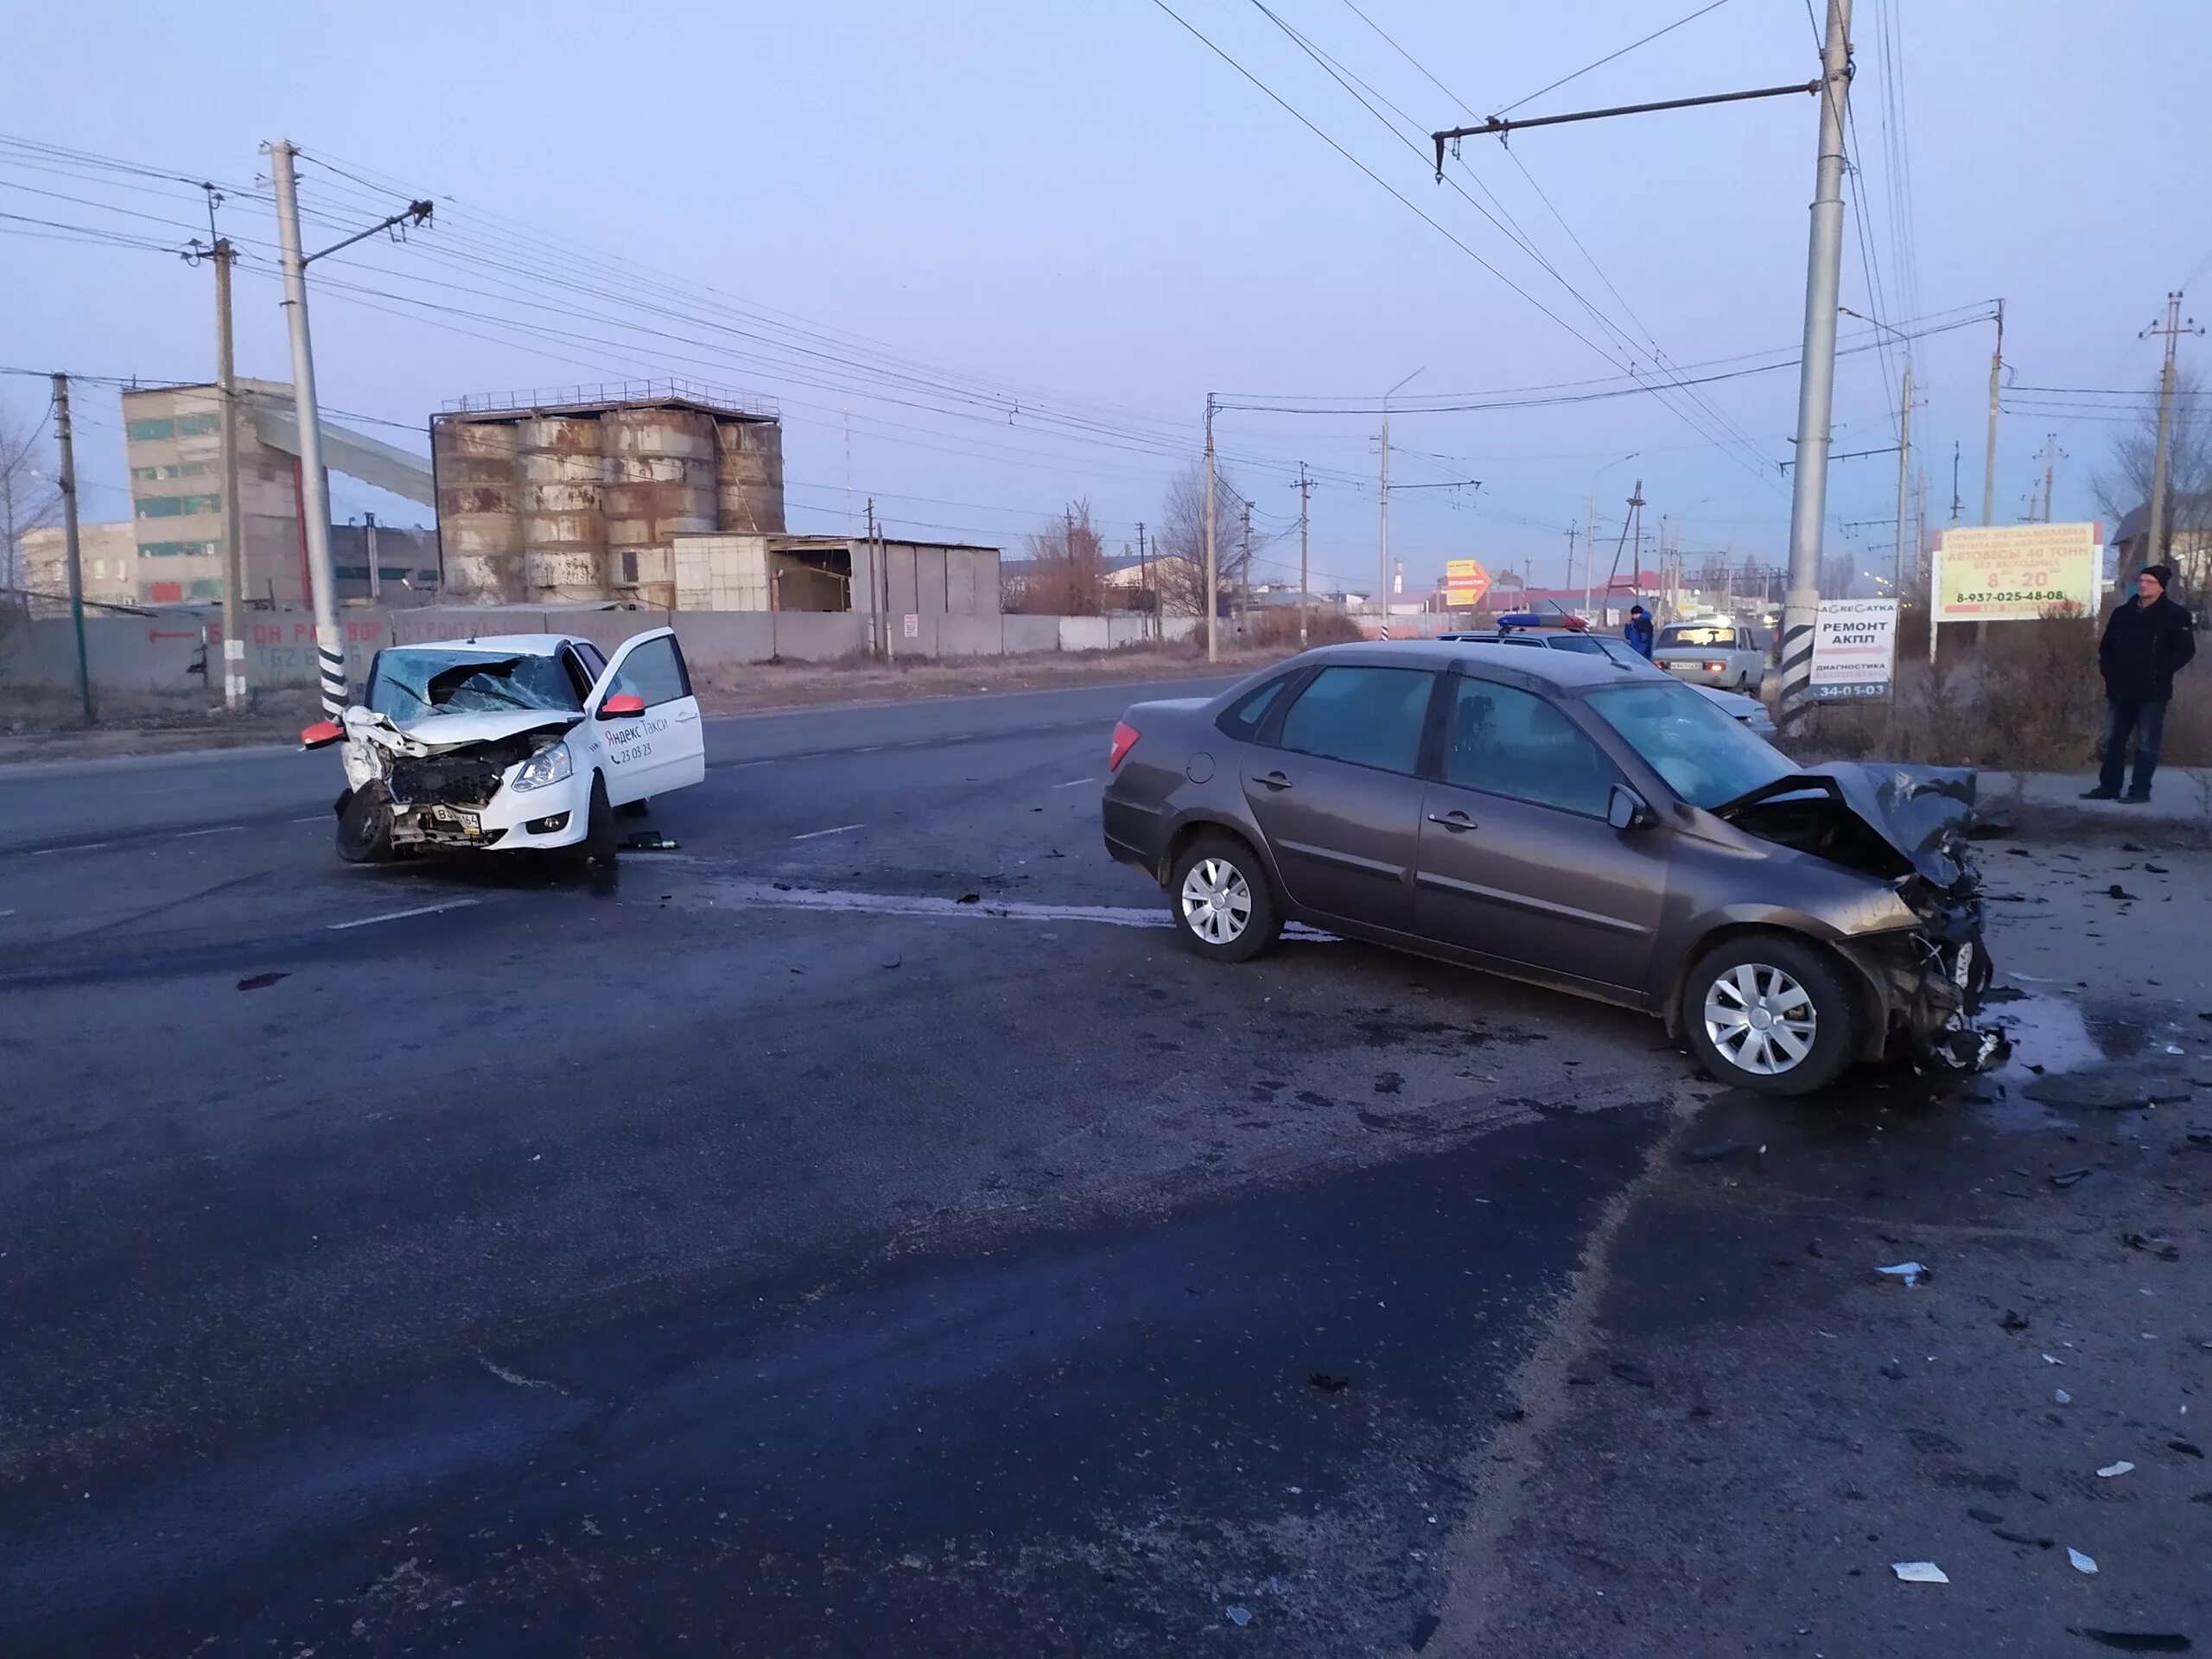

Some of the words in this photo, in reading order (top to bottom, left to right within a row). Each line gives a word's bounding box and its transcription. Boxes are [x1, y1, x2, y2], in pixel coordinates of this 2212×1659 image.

[1948, 549, 2020, 561] АВТОВЕСЫ
[2026, 549, 2044, 558] 40
[2050, 546, 2088, 556] ТОНН
[2021, 571, 2049, 587] 20
[1956, 591, 2063, 603] 8-937-025-48-08
[1823, 622, 1888, 632] РЕМОНТ
[1832, 635, 1876, 644] АКПП
[1815, 663, 1886, 671] ДИАГНОСТИКА
[1821, 685, 1885, 696] 34-05-03
[605, 726, 642, 747] Яндекс
[639, 718, 670, 735] Такси
[621, 750, 631, 763] 23
[632, 746, 642, 759] 03
[643, 743, 652, 756] 23
